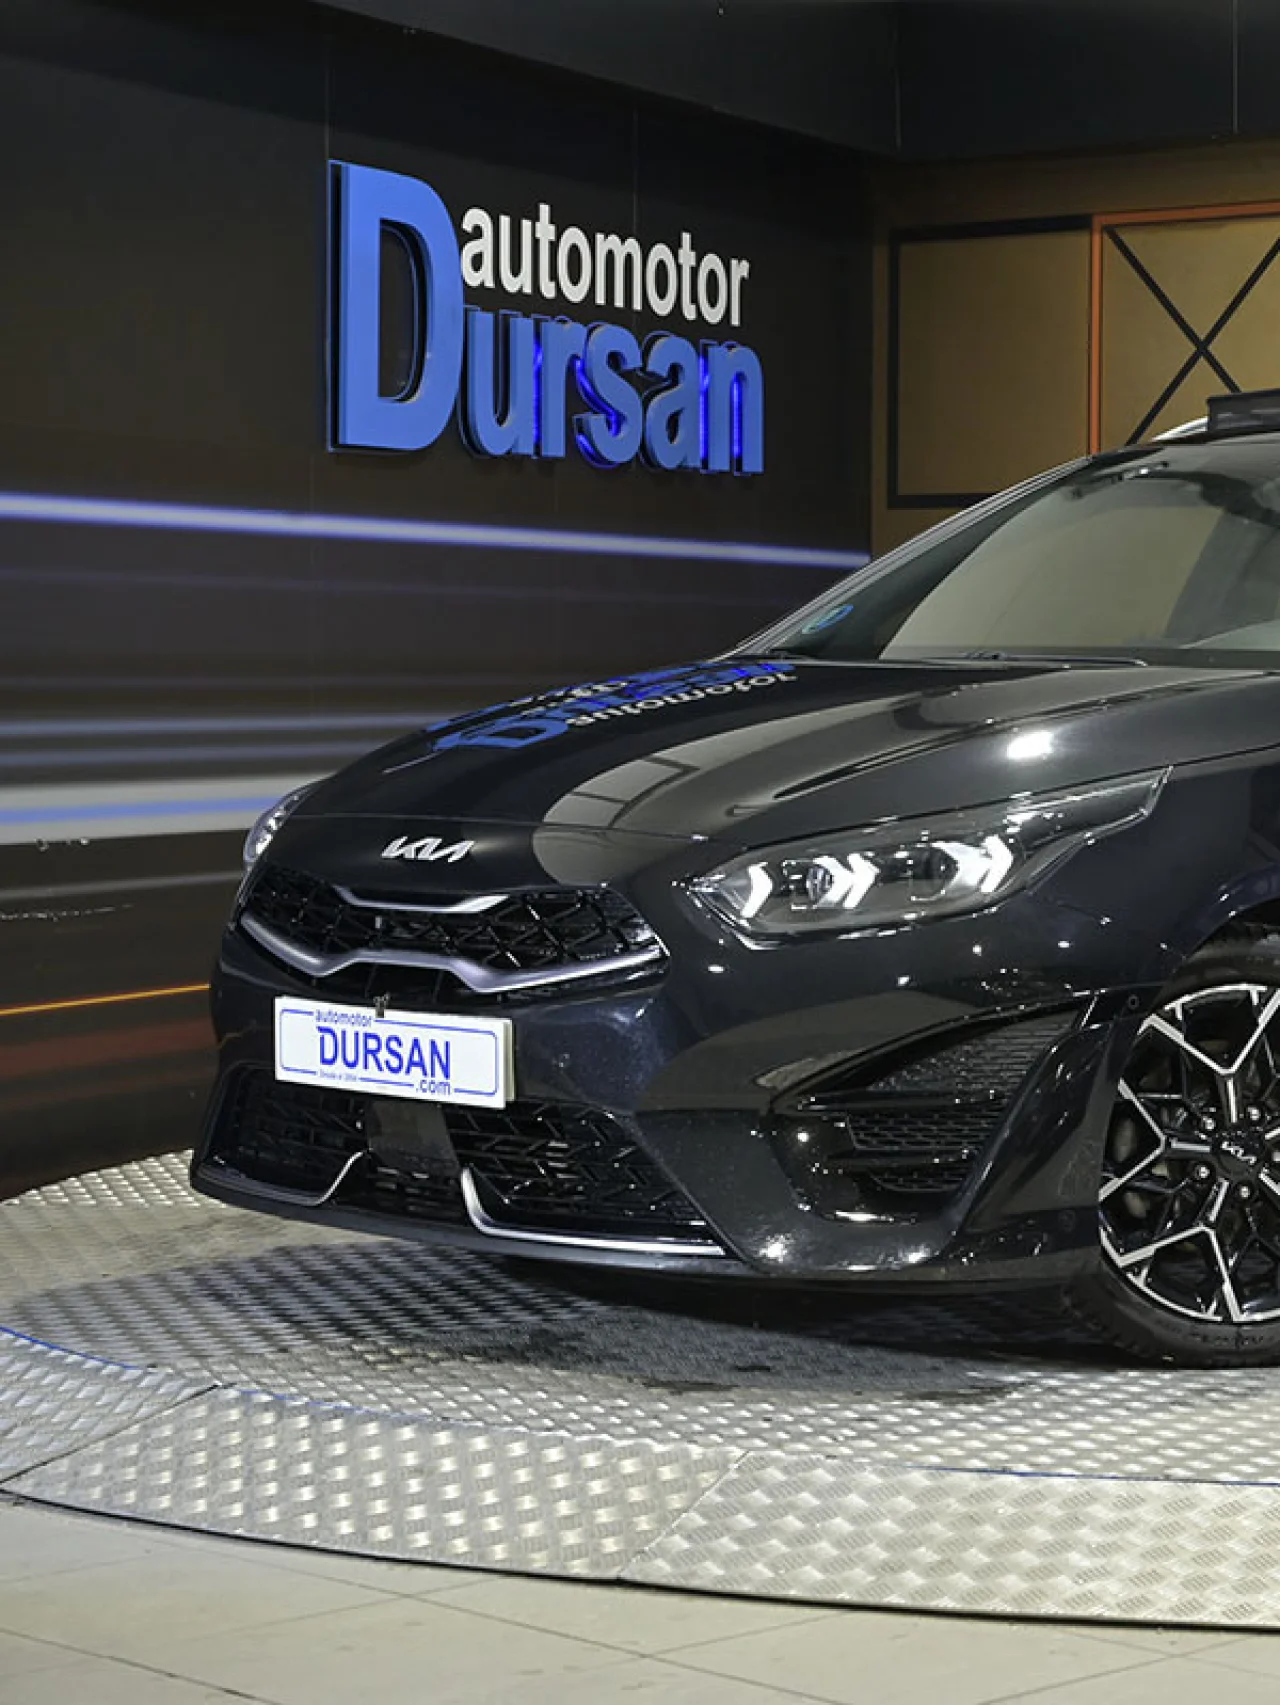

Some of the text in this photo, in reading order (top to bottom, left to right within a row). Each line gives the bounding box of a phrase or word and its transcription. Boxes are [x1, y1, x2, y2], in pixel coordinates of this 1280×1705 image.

[329, 159, 765, 475] Dursan
[461, 202, 750, 326] automotor
[316, 1025, 451, 1080] DURSAN
